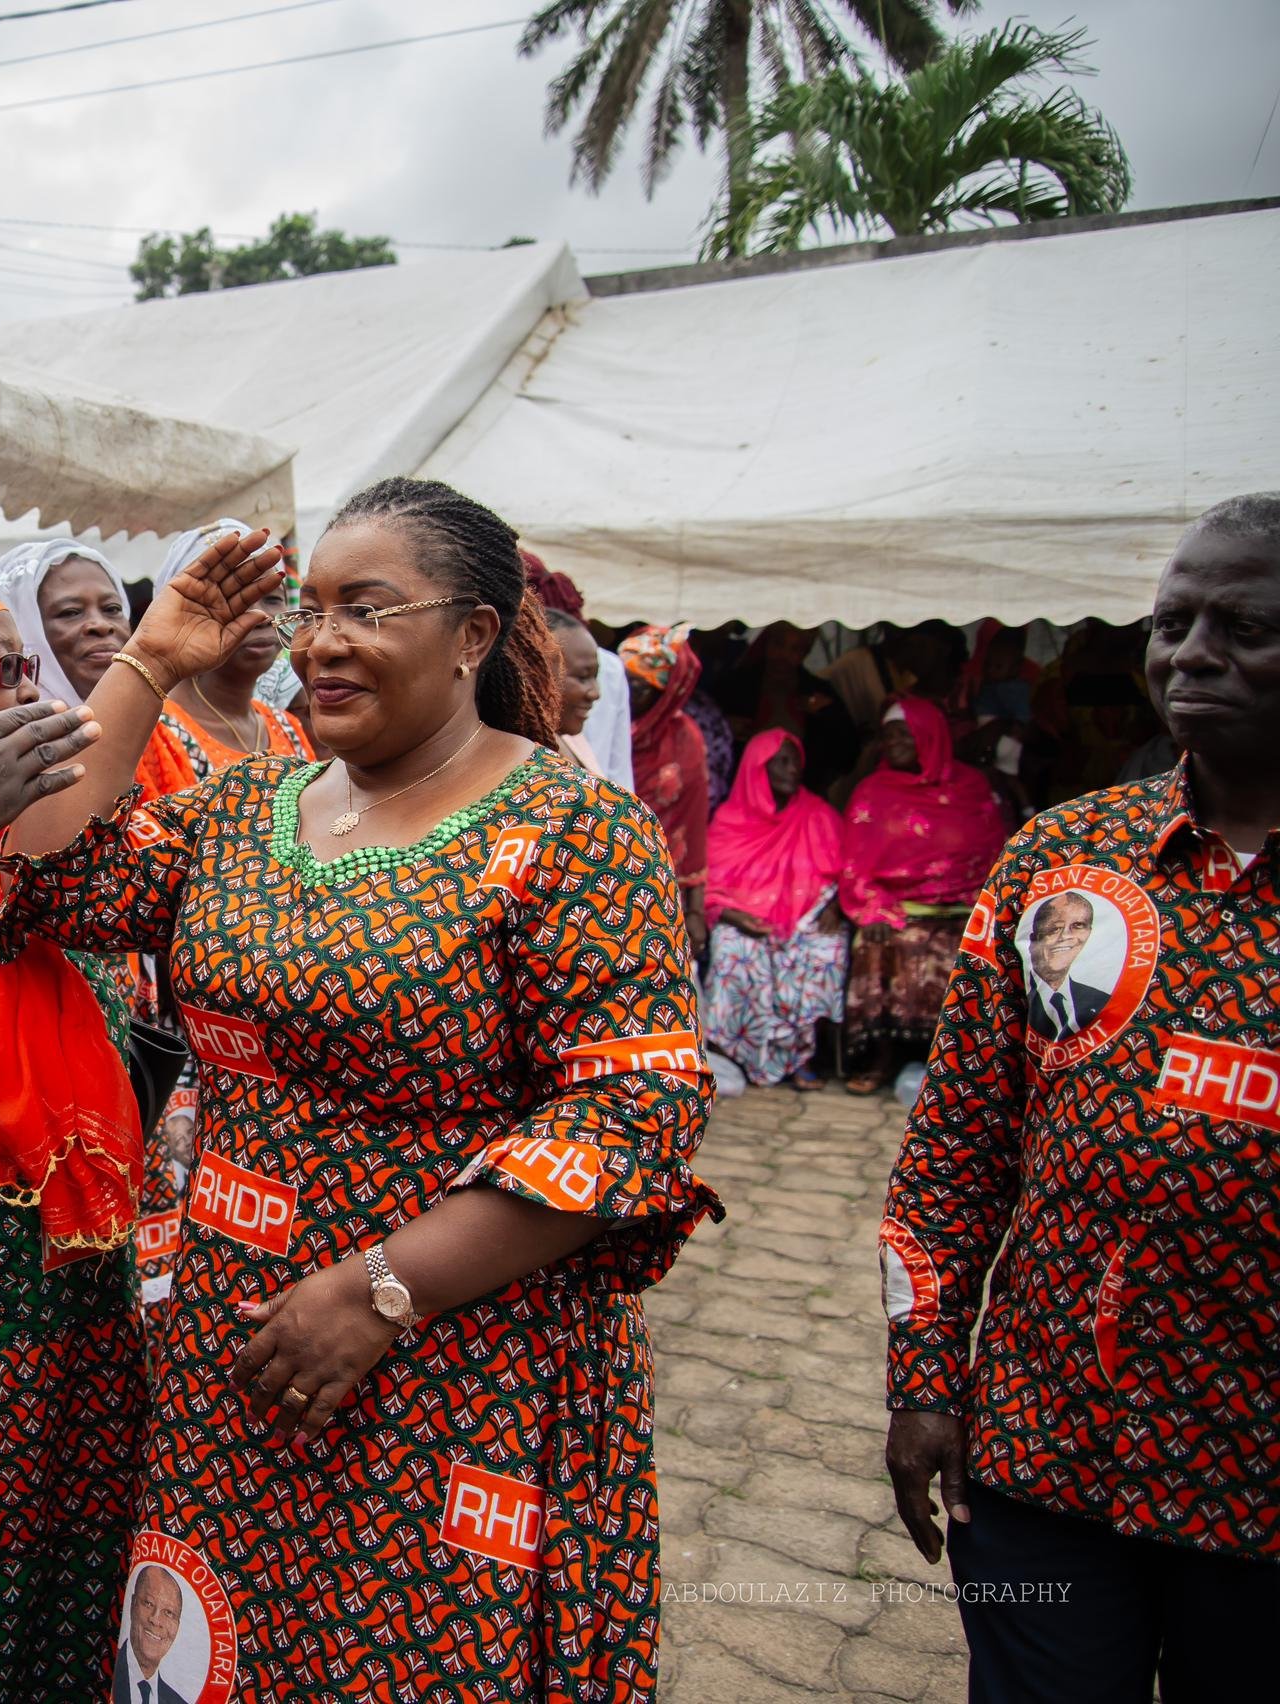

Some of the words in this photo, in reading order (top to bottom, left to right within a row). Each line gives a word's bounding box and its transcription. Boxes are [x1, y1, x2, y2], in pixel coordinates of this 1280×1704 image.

[1101, 876, 1156, 969] OUATTARA
[1159, 1047, 1280, 1112] RHD
[193, 1164, 289, 1234] RHDP
[450, 1481, 546, 1554] RHD
[190, 1564, 234, 1687] OUATTARA
